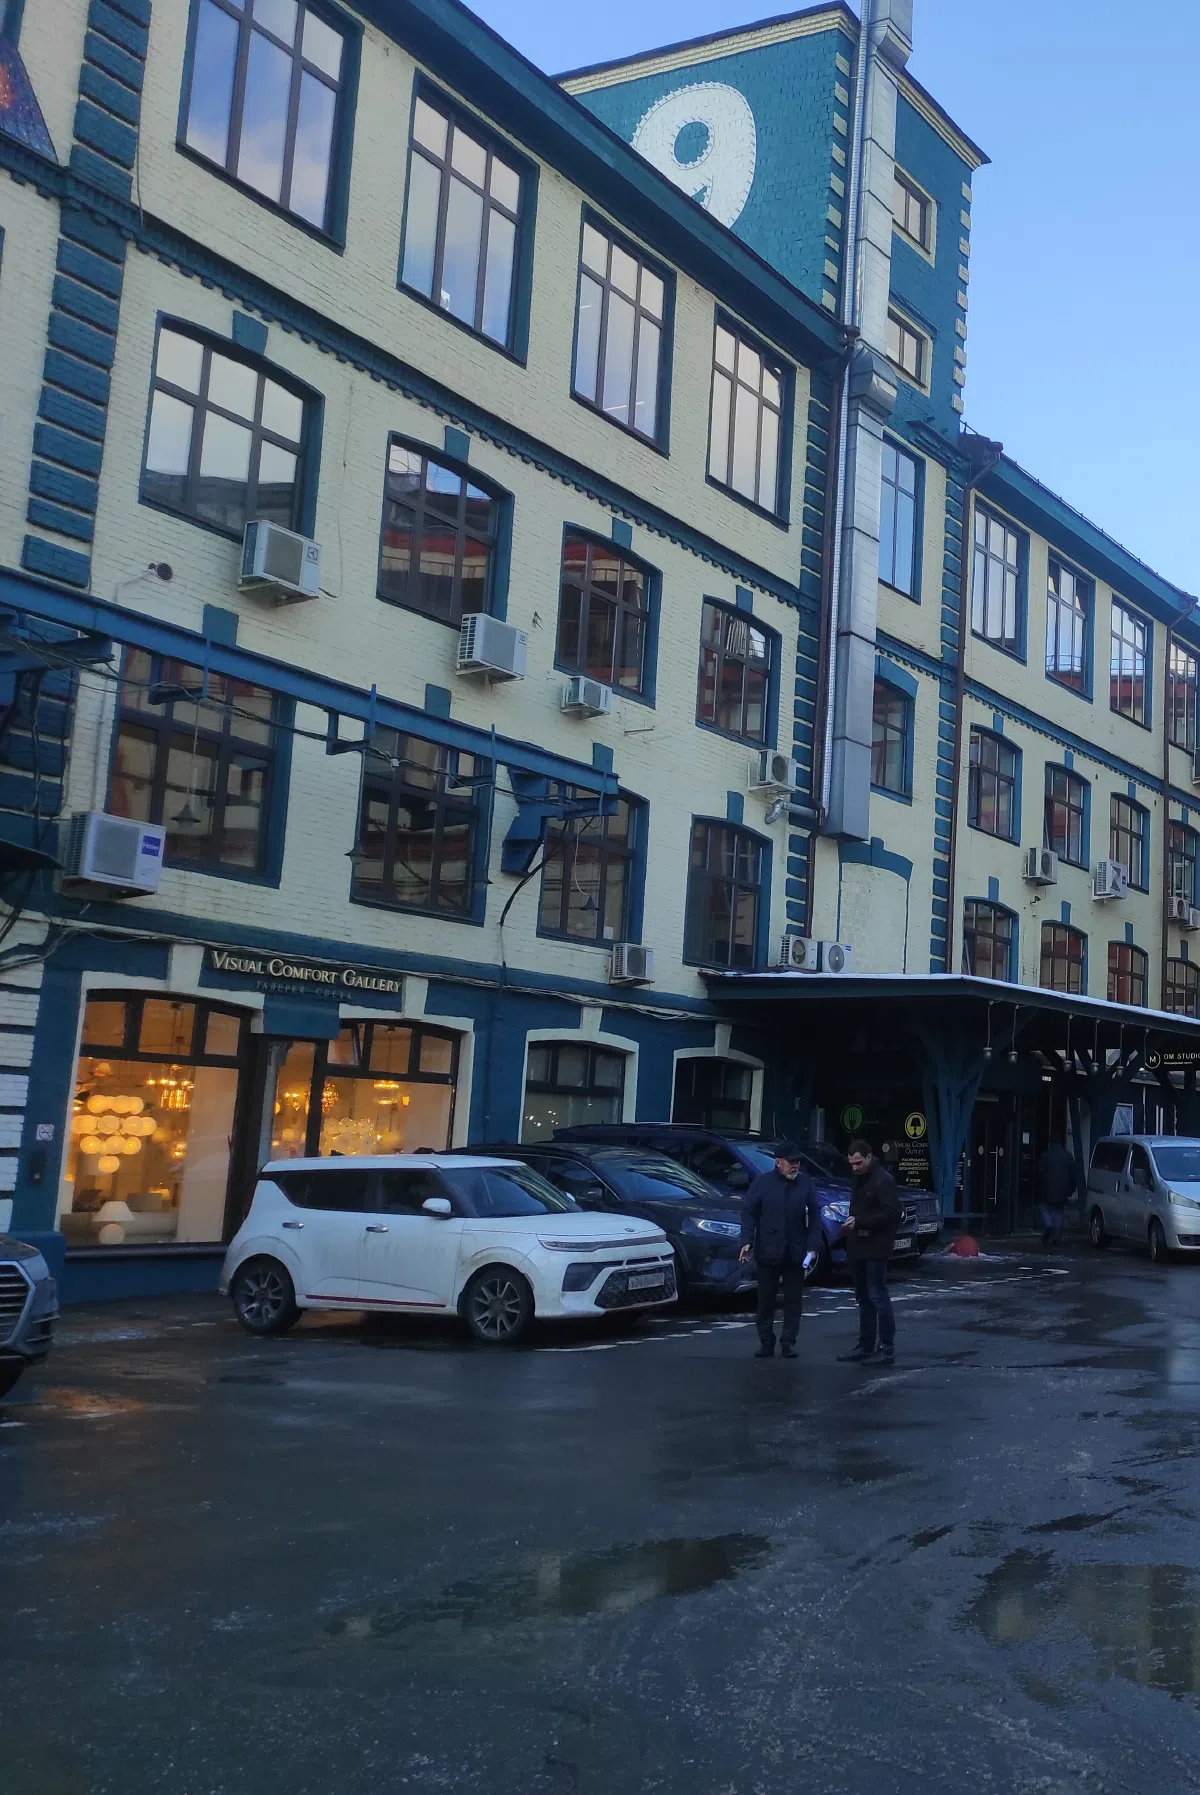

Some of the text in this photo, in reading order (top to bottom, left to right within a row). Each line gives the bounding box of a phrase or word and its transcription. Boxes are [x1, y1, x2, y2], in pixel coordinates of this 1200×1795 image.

[630, 80, 757, 230] 9
[212, 950, 403, 993] VISUAL COMFORT GALLERY
